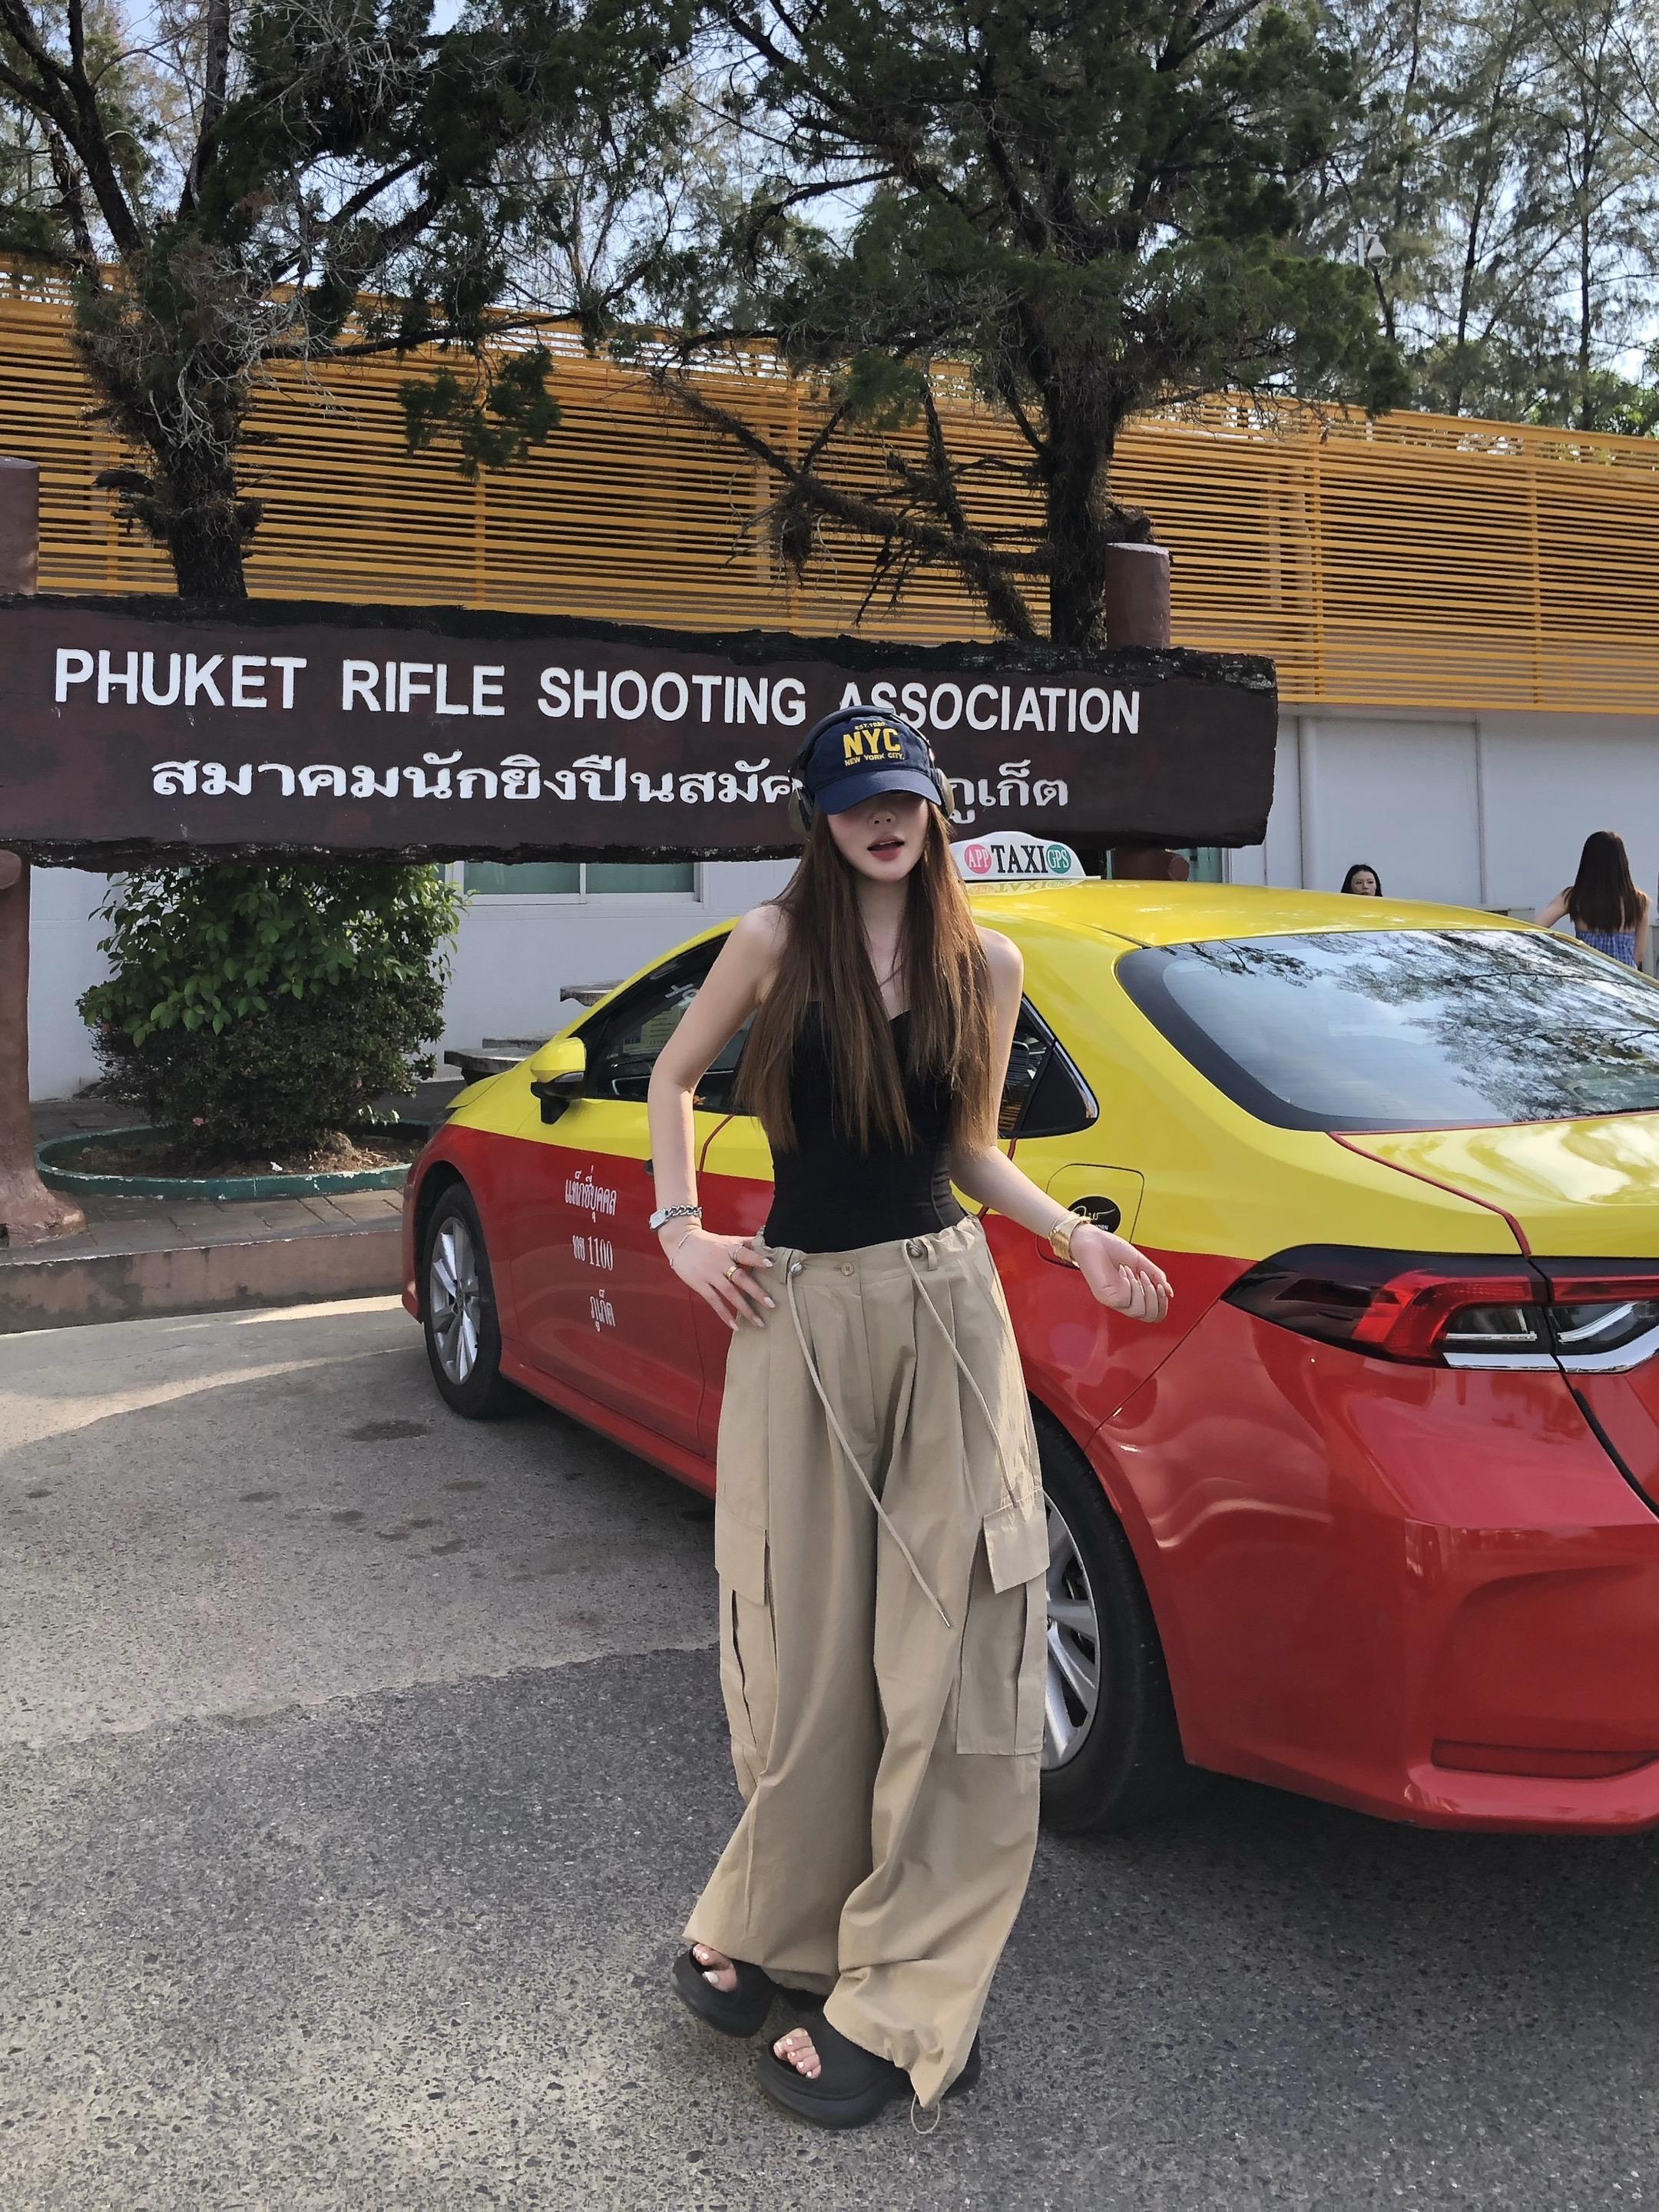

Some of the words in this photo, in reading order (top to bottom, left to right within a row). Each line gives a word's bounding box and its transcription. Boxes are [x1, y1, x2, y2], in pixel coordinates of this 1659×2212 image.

[55, 647, 307, 709] PHUKET
[342, 658, 505, 716] RIFLE
[538, 667, 806, 726] SHOOTING
[839, 681, 1140, 734] ASSOCIATION
[843, 728, 902, 759] NYC
[844, 757, 861, 767] NEW
[969, 849, 989, 868] APP
[991, 844, 1048, 874] TAXI
[1047, 849, 1069, 869] GPS
[588, 1236, 614, 1271] 1100
[590, 1289, 616, 1333] ภูเก็ต
